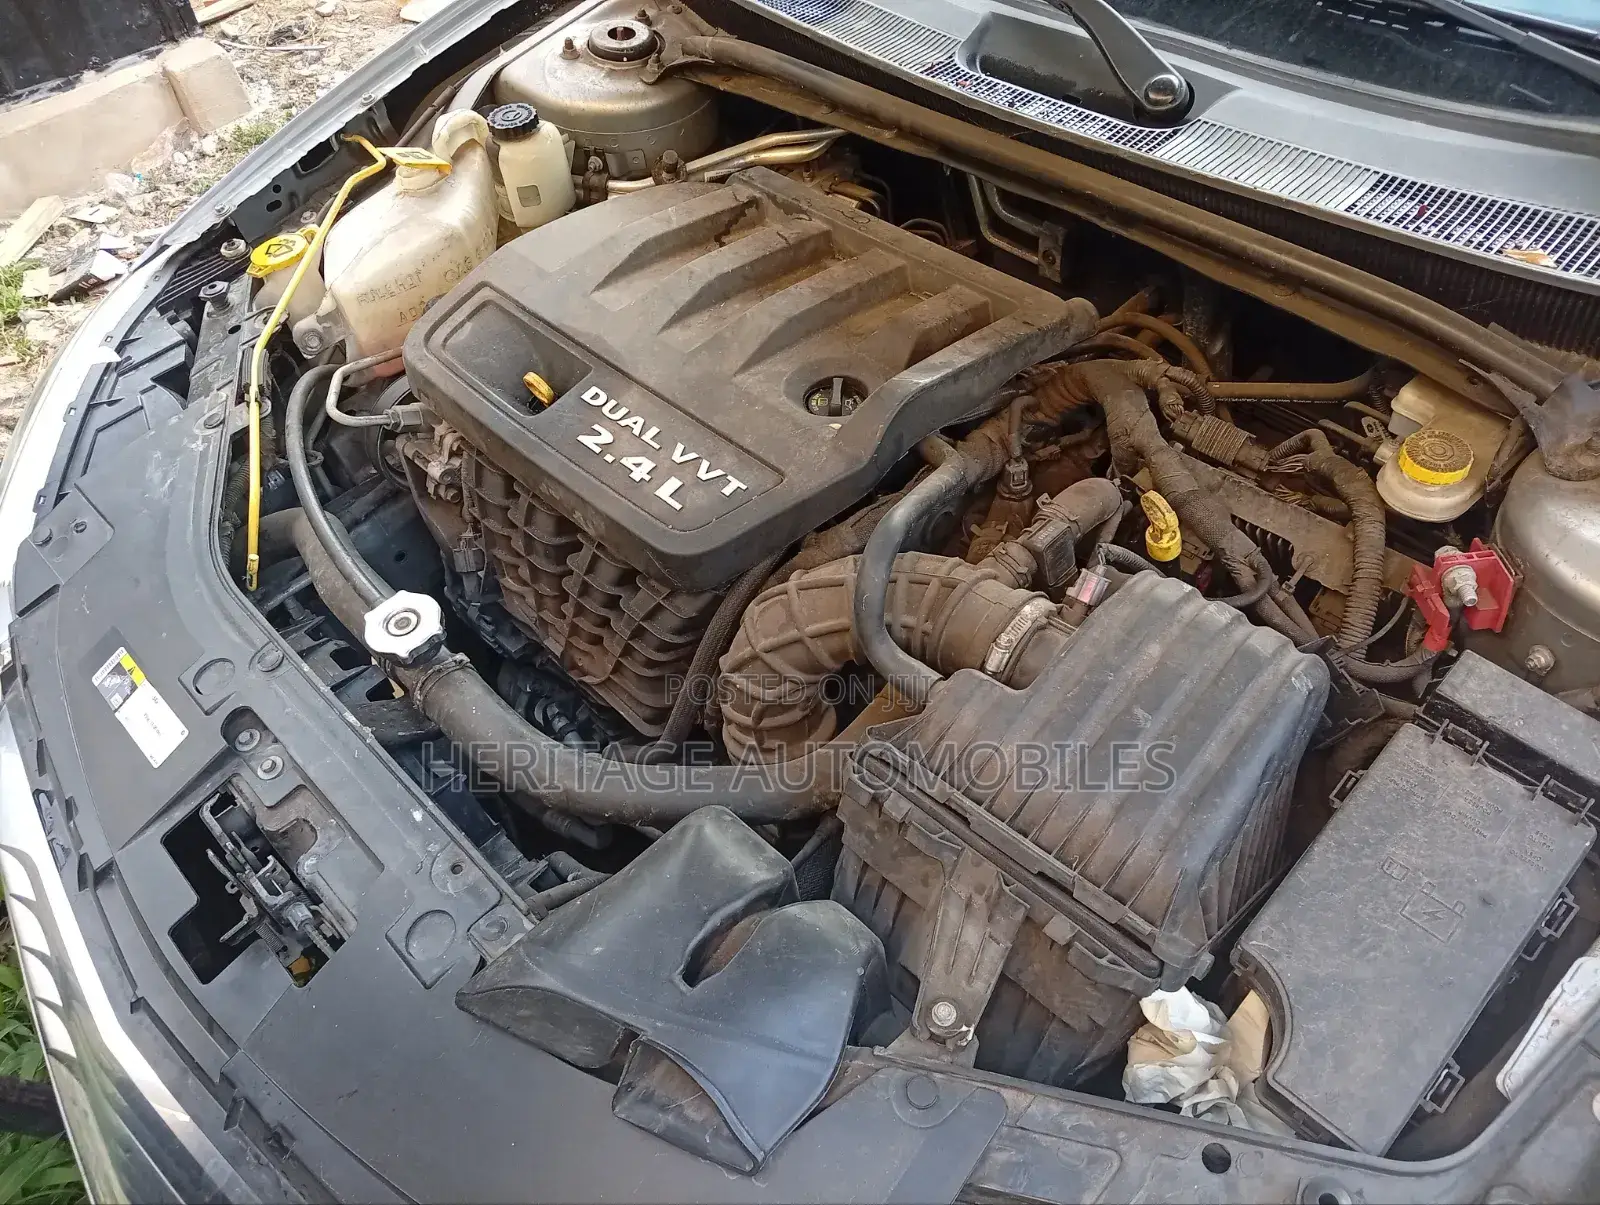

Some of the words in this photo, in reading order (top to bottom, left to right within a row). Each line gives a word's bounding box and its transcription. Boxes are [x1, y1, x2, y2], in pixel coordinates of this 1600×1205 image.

[576, 423, 657, 483] 2.4
[653, 475, 684, 511] L
[580, 385, 661, 450] DUAL
[671, 442, 748, 497] VVT
